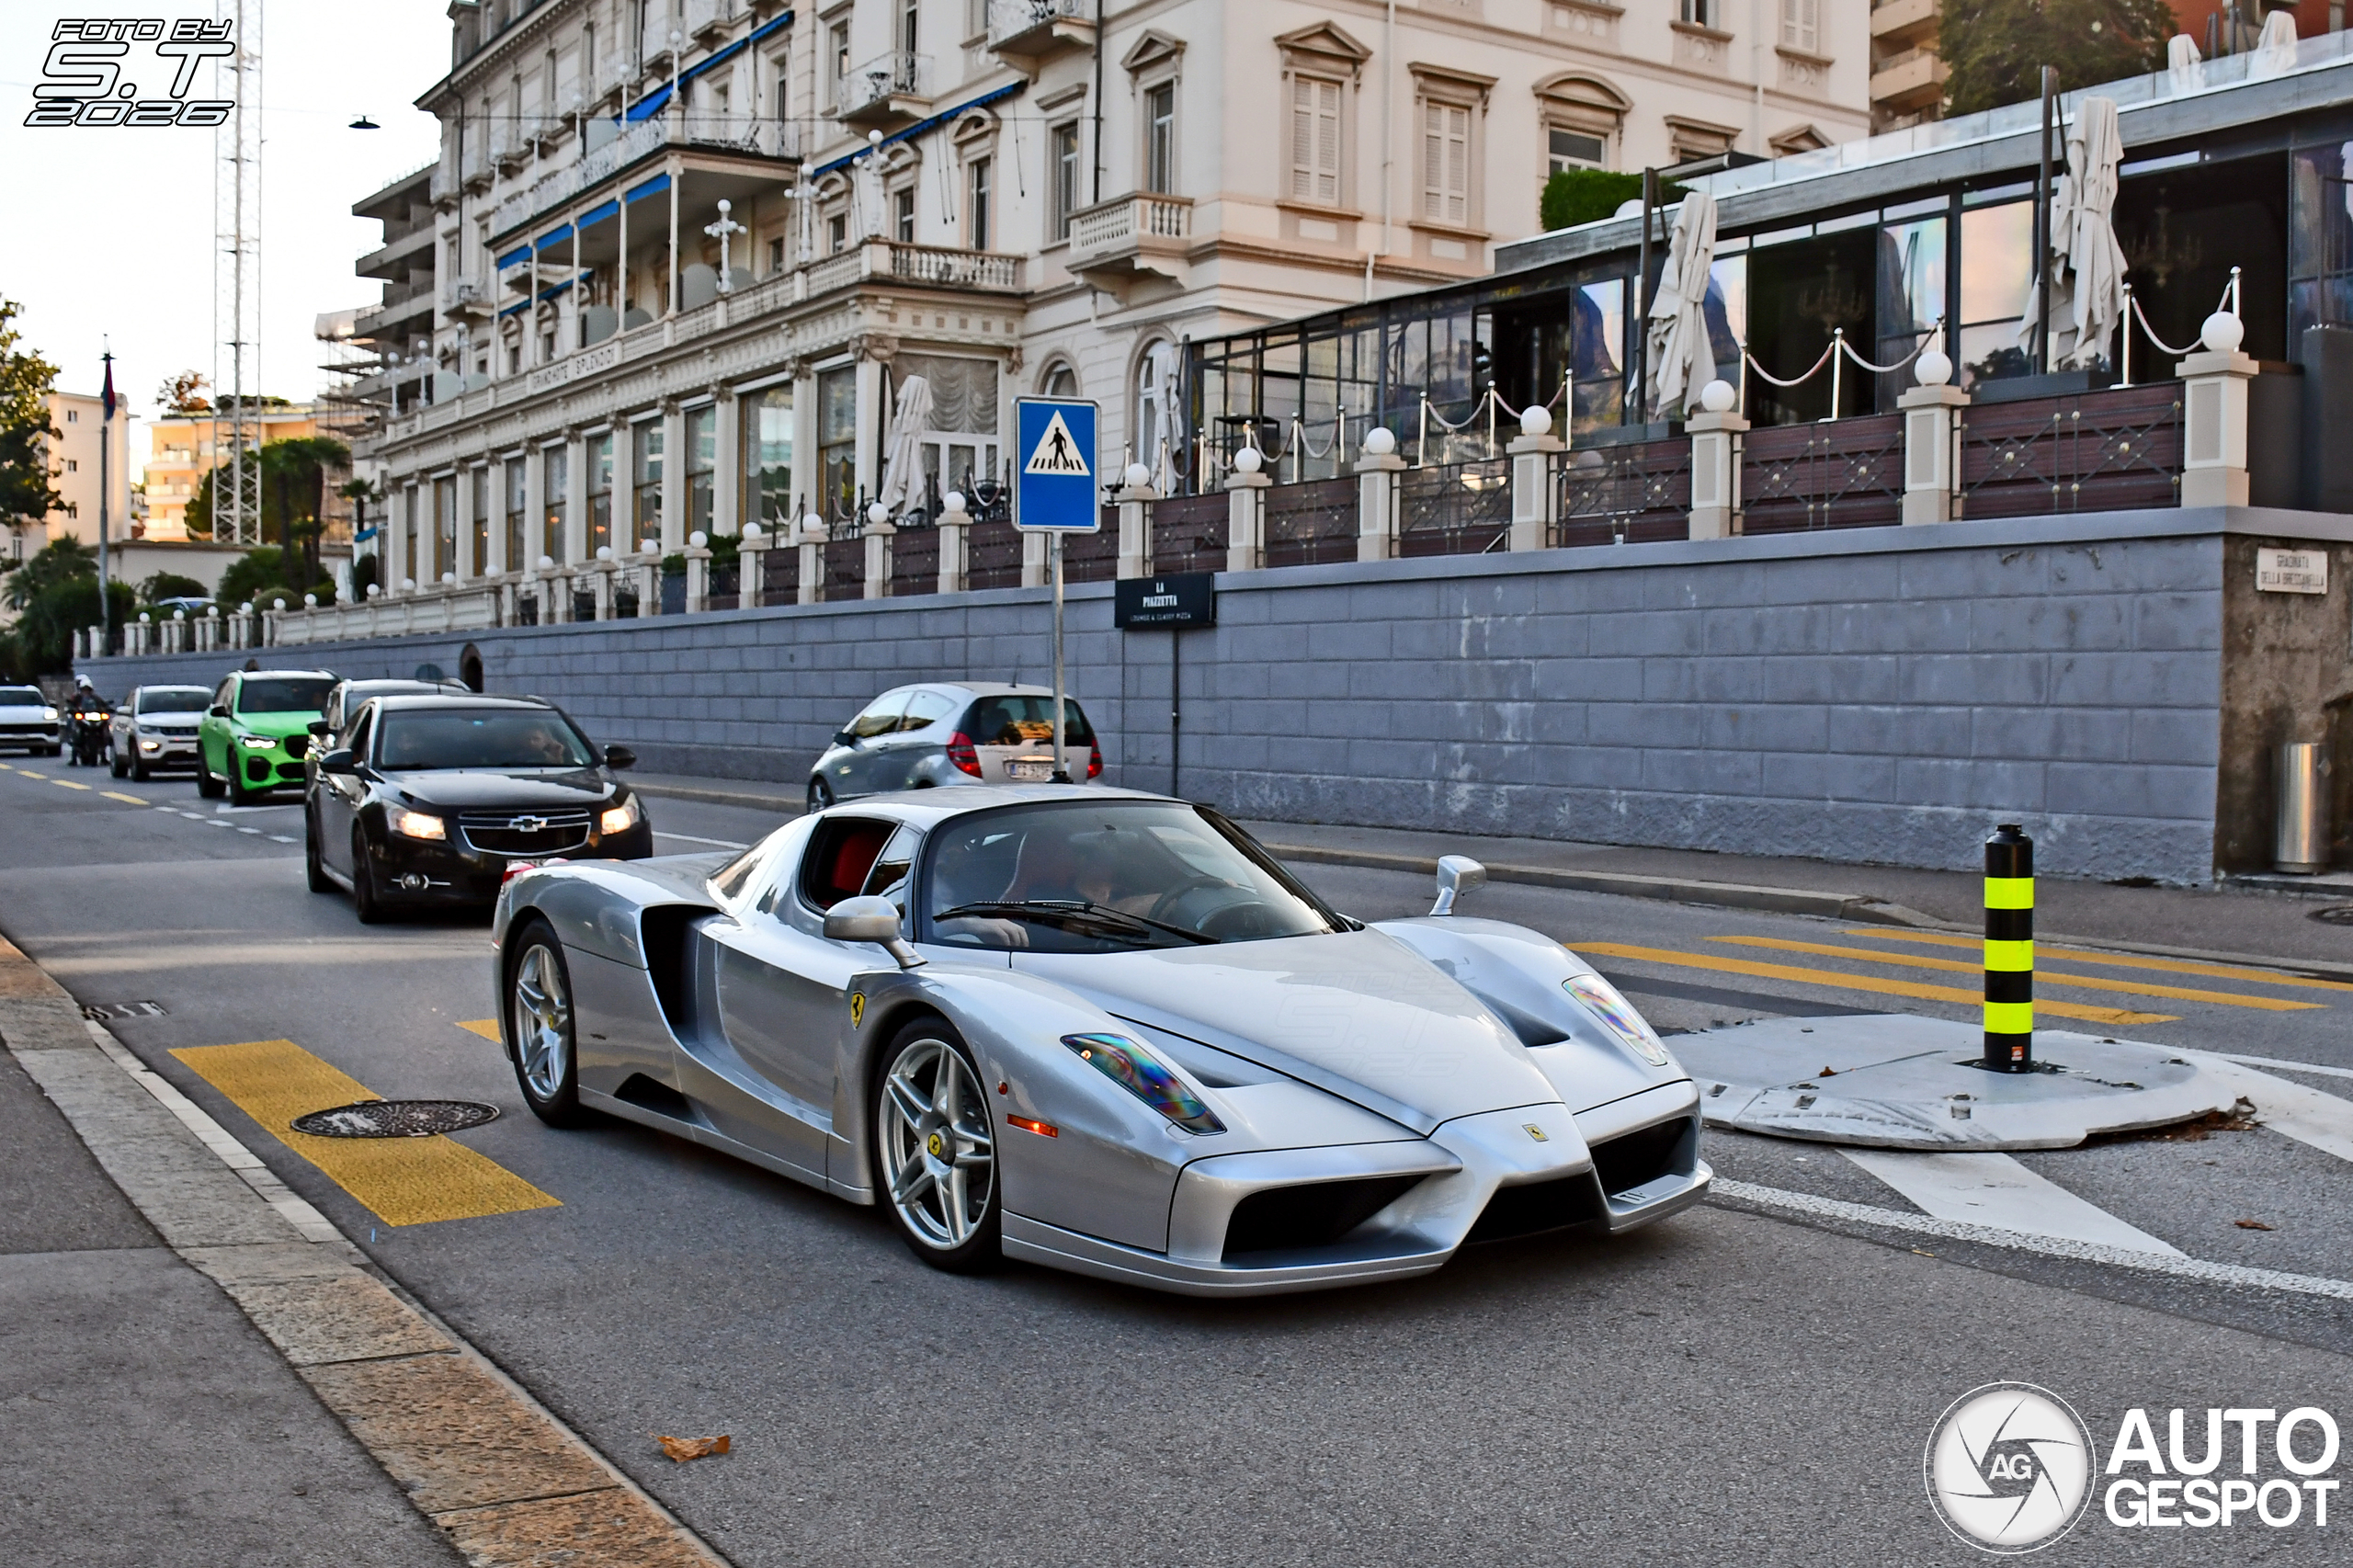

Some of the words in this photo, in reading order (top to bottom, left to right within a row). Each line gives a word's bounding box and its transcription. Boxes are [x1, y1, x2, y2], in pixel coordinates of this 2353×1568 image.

[1156, 582, 1165, 593] LA
[1142, 595, 1177, 608] PIAZZETTA
[1176, 611, 1191, 619] PIZZA
